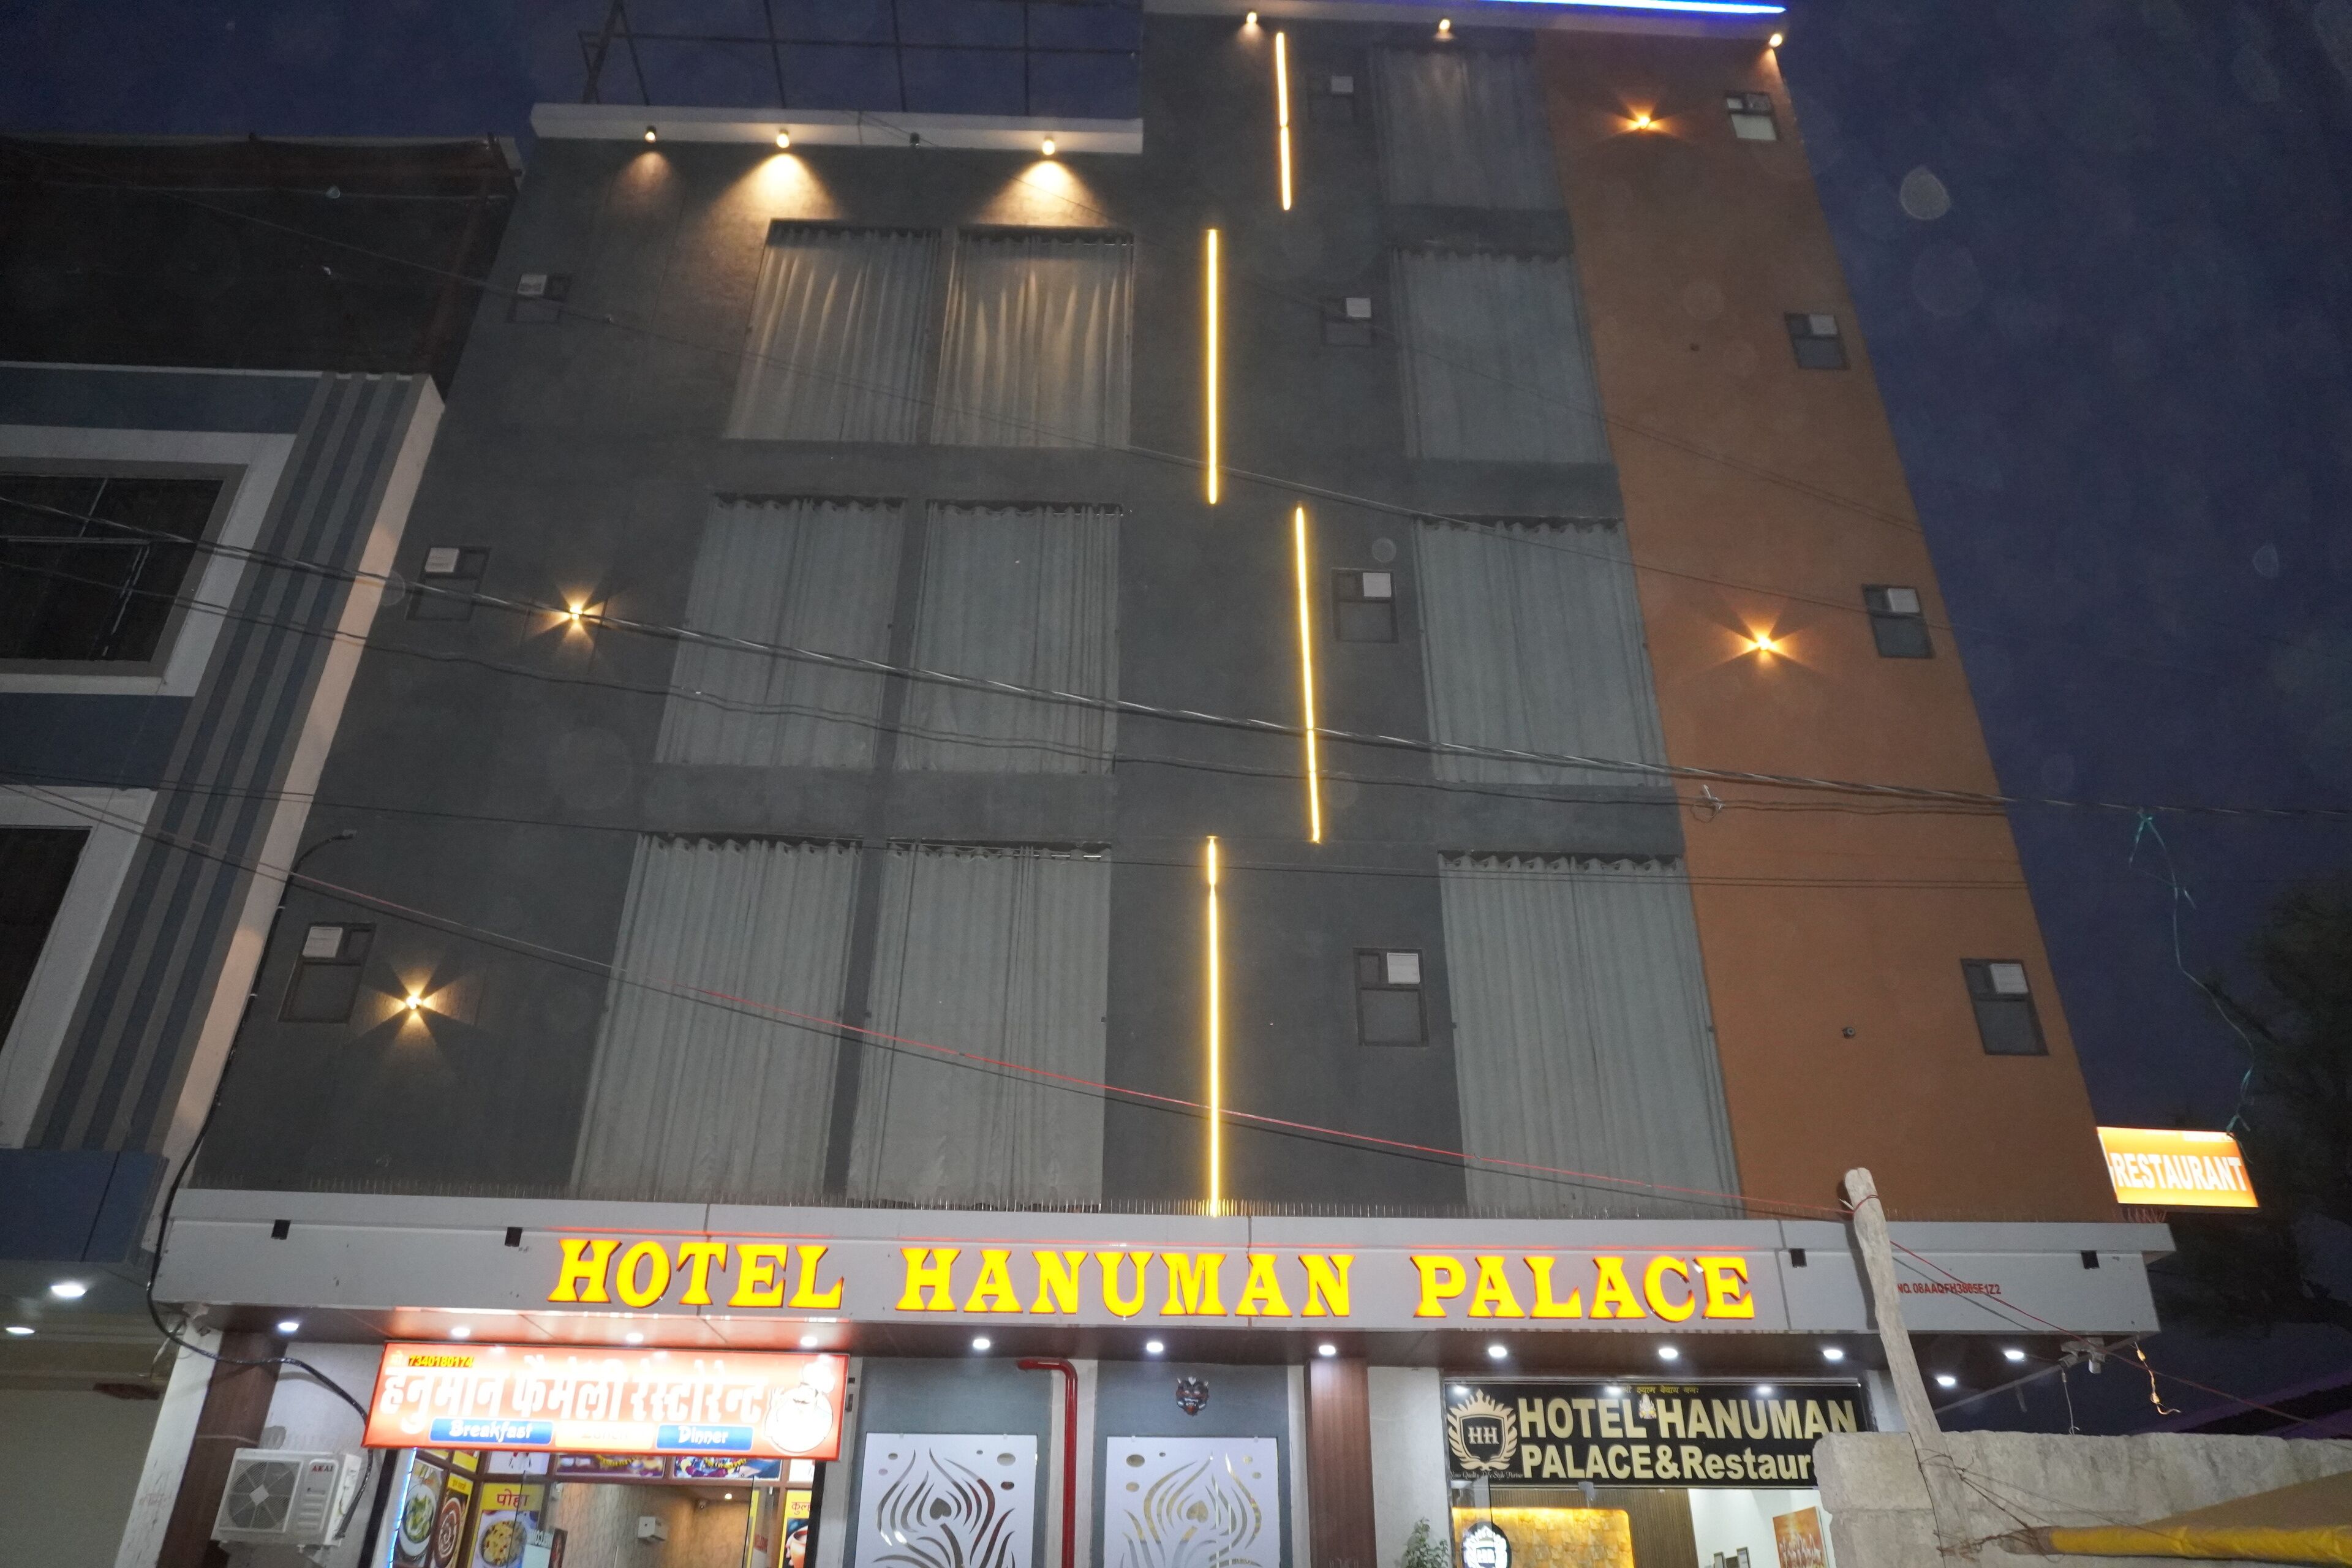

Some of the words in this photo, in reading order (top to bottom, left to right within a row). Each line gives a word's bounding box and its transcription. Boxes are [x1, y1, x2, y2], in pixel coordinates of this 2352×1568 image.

[2109, 1152, 2247, 1191] RESTAURANT
[546, 1238, 843, 1309] HOTEL
[894, 1247, 1357, 1318] HANUMAN
[1411, 1254, 1756, 1322] PALACE
[409, 1355, 474, 1368] 7340180174
[380, 1366, 508, 1434] हनुमान
[448, 1420, 532, 1443] Breakfast
[1518, 1397, 1647, 1439] HOTEL
[1655, 1398, 1857, 1439] HANUMAN
[678, 1425, 729, 1444] Dinner
[1468, 1426, 1500, 1444] HH
